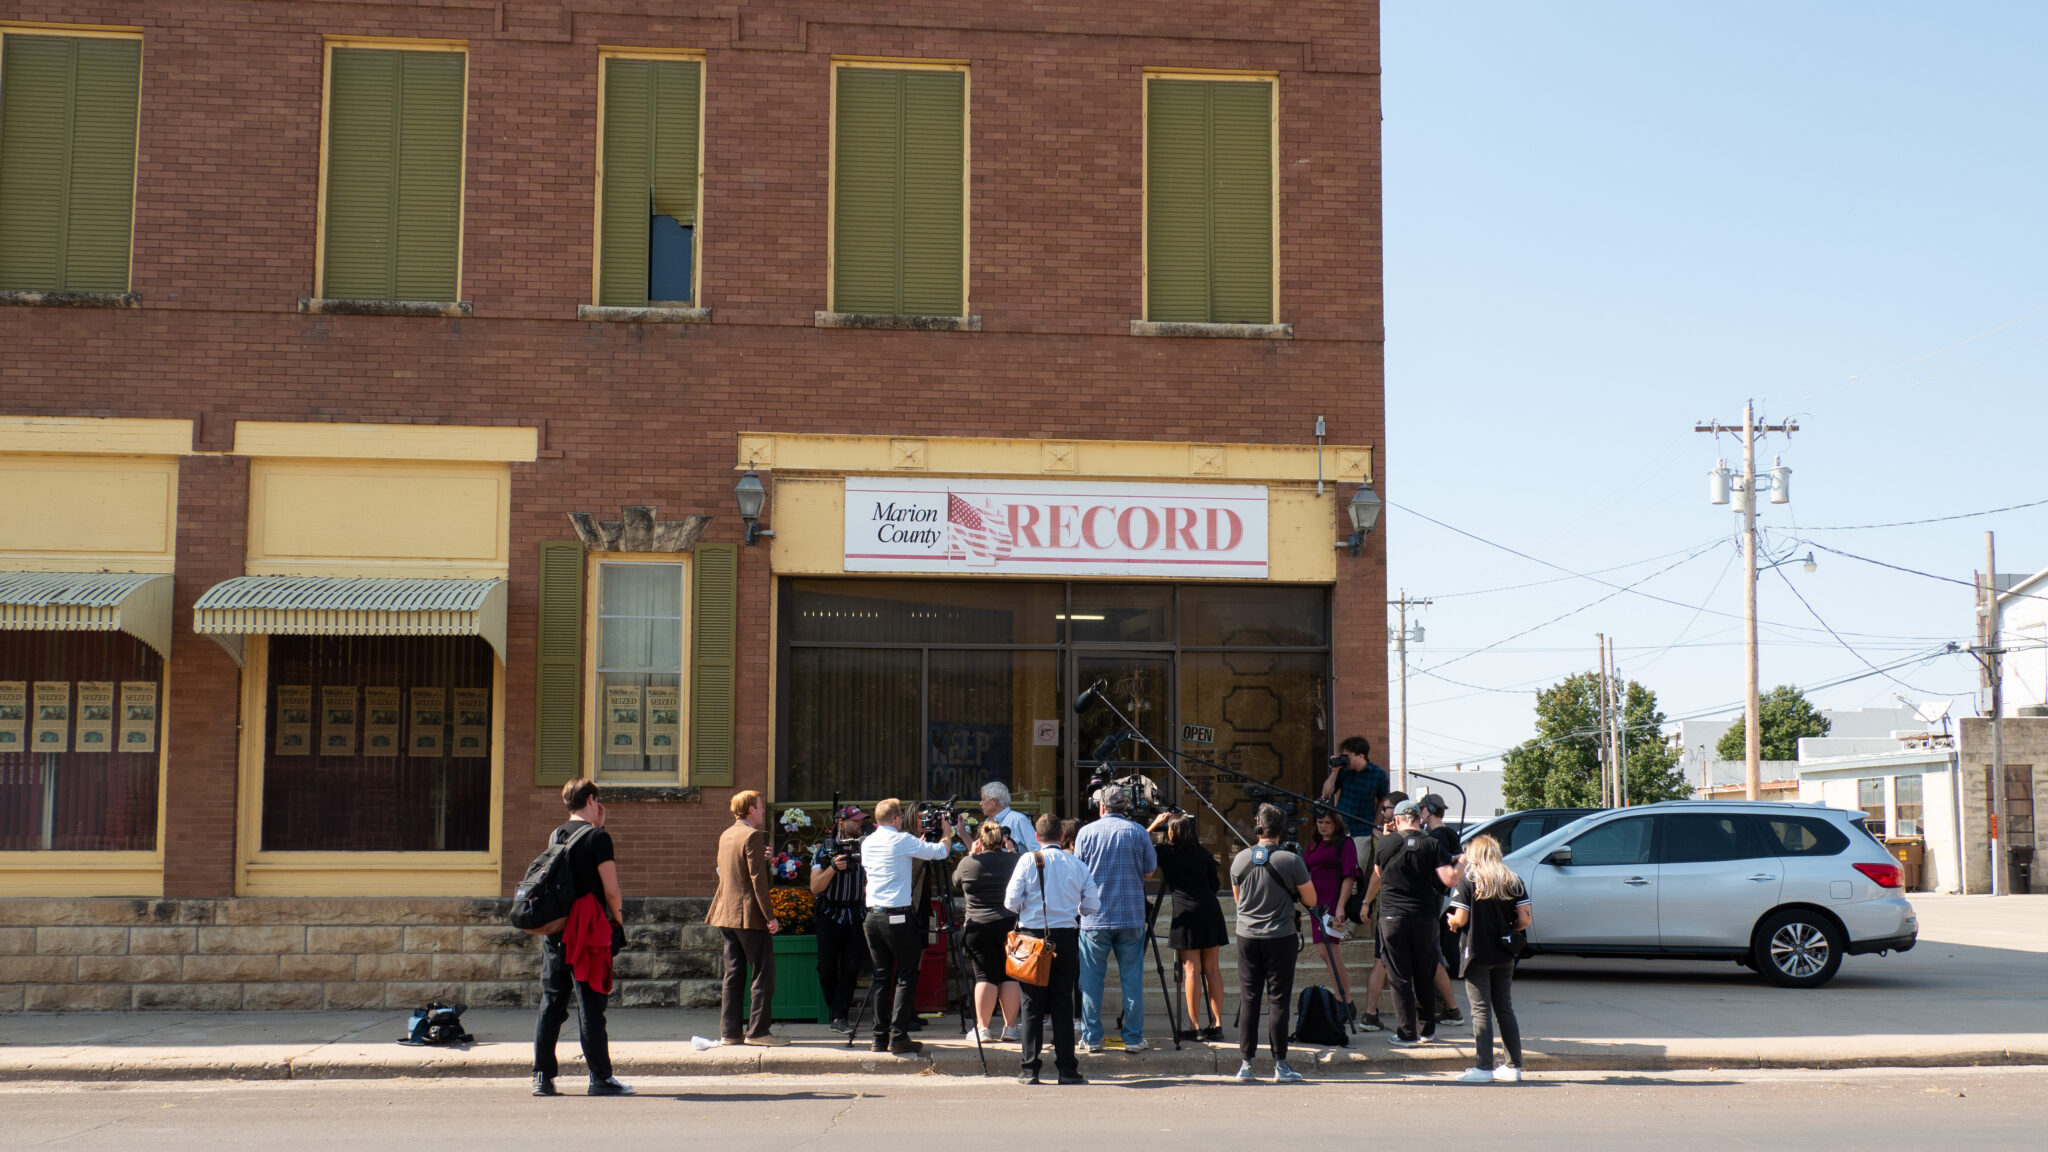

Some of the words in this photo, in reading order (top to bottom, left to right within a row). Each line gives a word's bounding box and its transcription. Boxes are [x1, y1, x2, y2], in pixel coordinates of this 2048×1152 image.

[871, 501, 938, 523] Marion
[877, 523, 941, 549] County
[1004, 503, 1244, 553] RECORD
[1183, 725, 1213, 742] OPEN
[932, 730, 991, 766] KEEP
